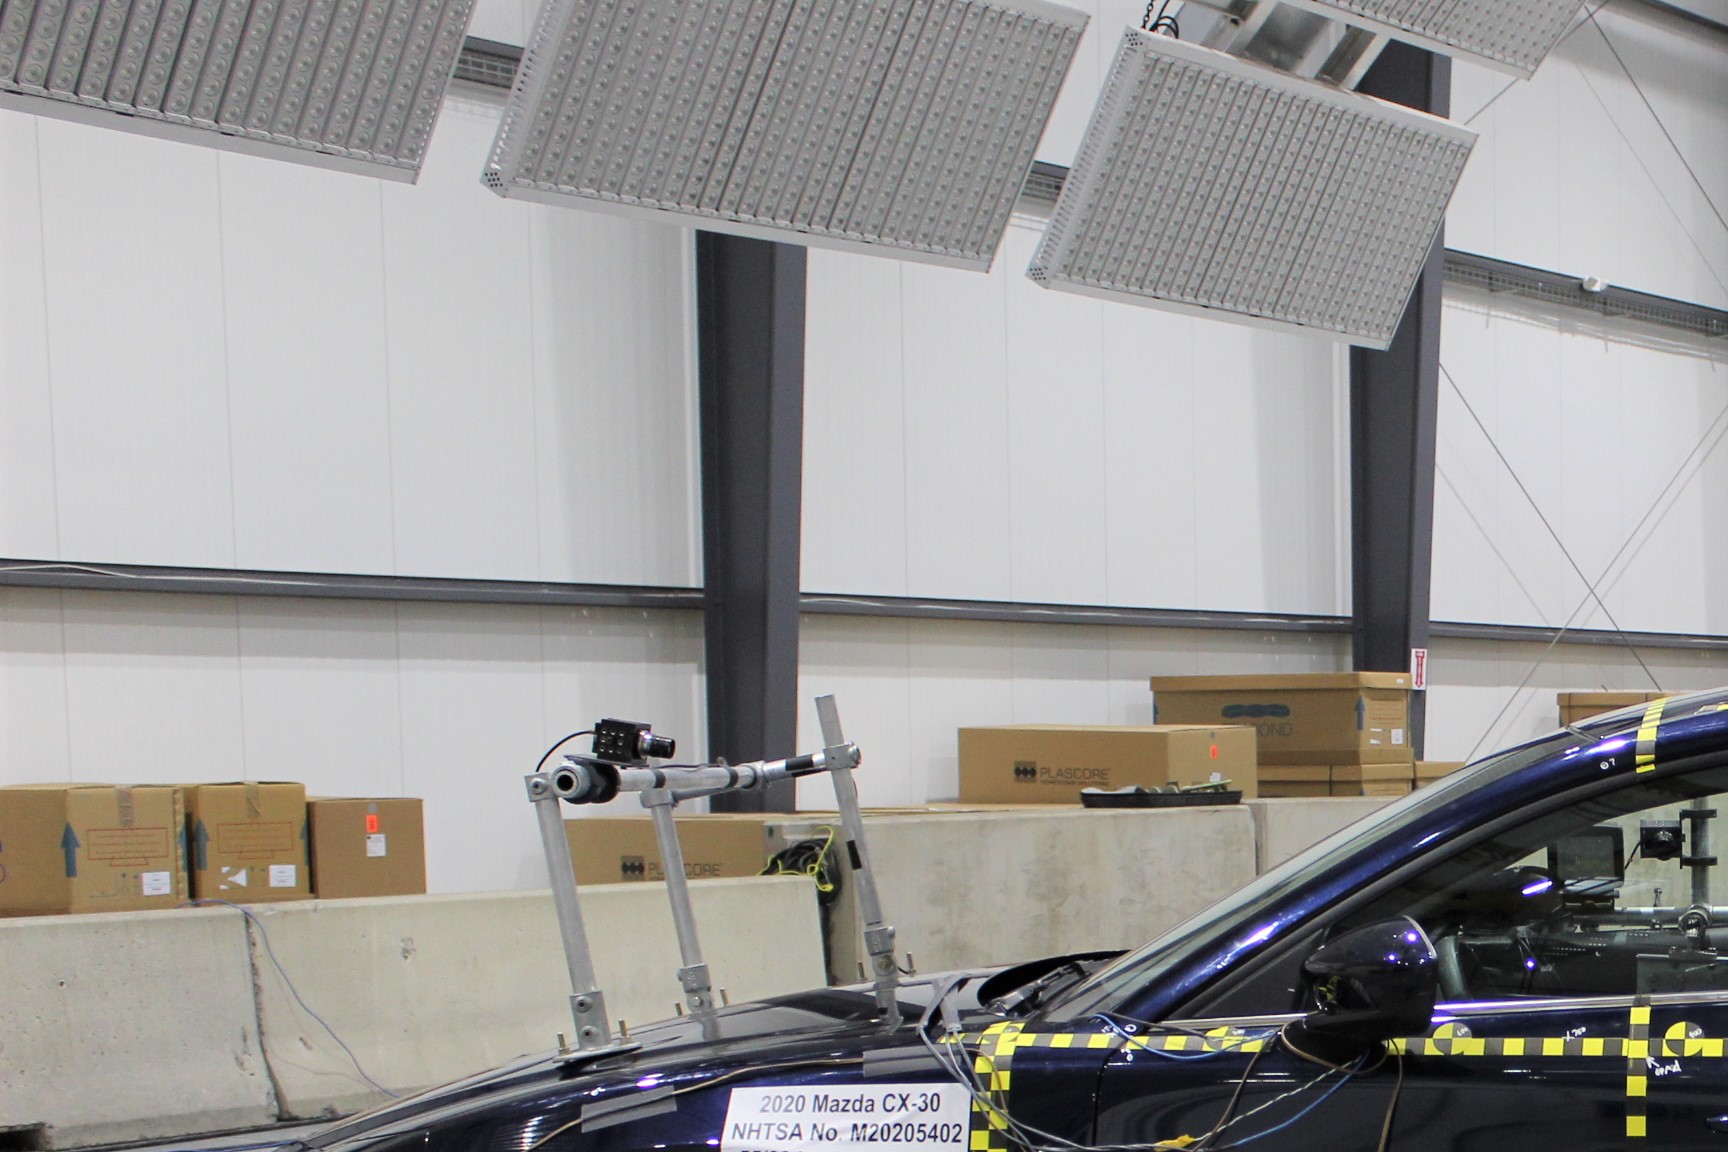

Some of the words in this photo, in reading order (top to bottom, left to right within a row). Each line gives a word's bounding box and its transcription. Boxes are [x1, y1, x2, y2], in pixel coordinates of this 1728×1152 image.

[1040, 768, 1108, 780] PLASCORE
[648, 863, 720, 877] PLCORE
[760, 1095, 805, 1113] 2020
[812, 1094, 875, 1113] Mazda
[882, 1093, 941, 1112] CX-30
[732, 1123, 803, 1141] NHTSA
[810, 1124, 842, 1141] No.
[850, 1123, 962, 1143] M20205402
